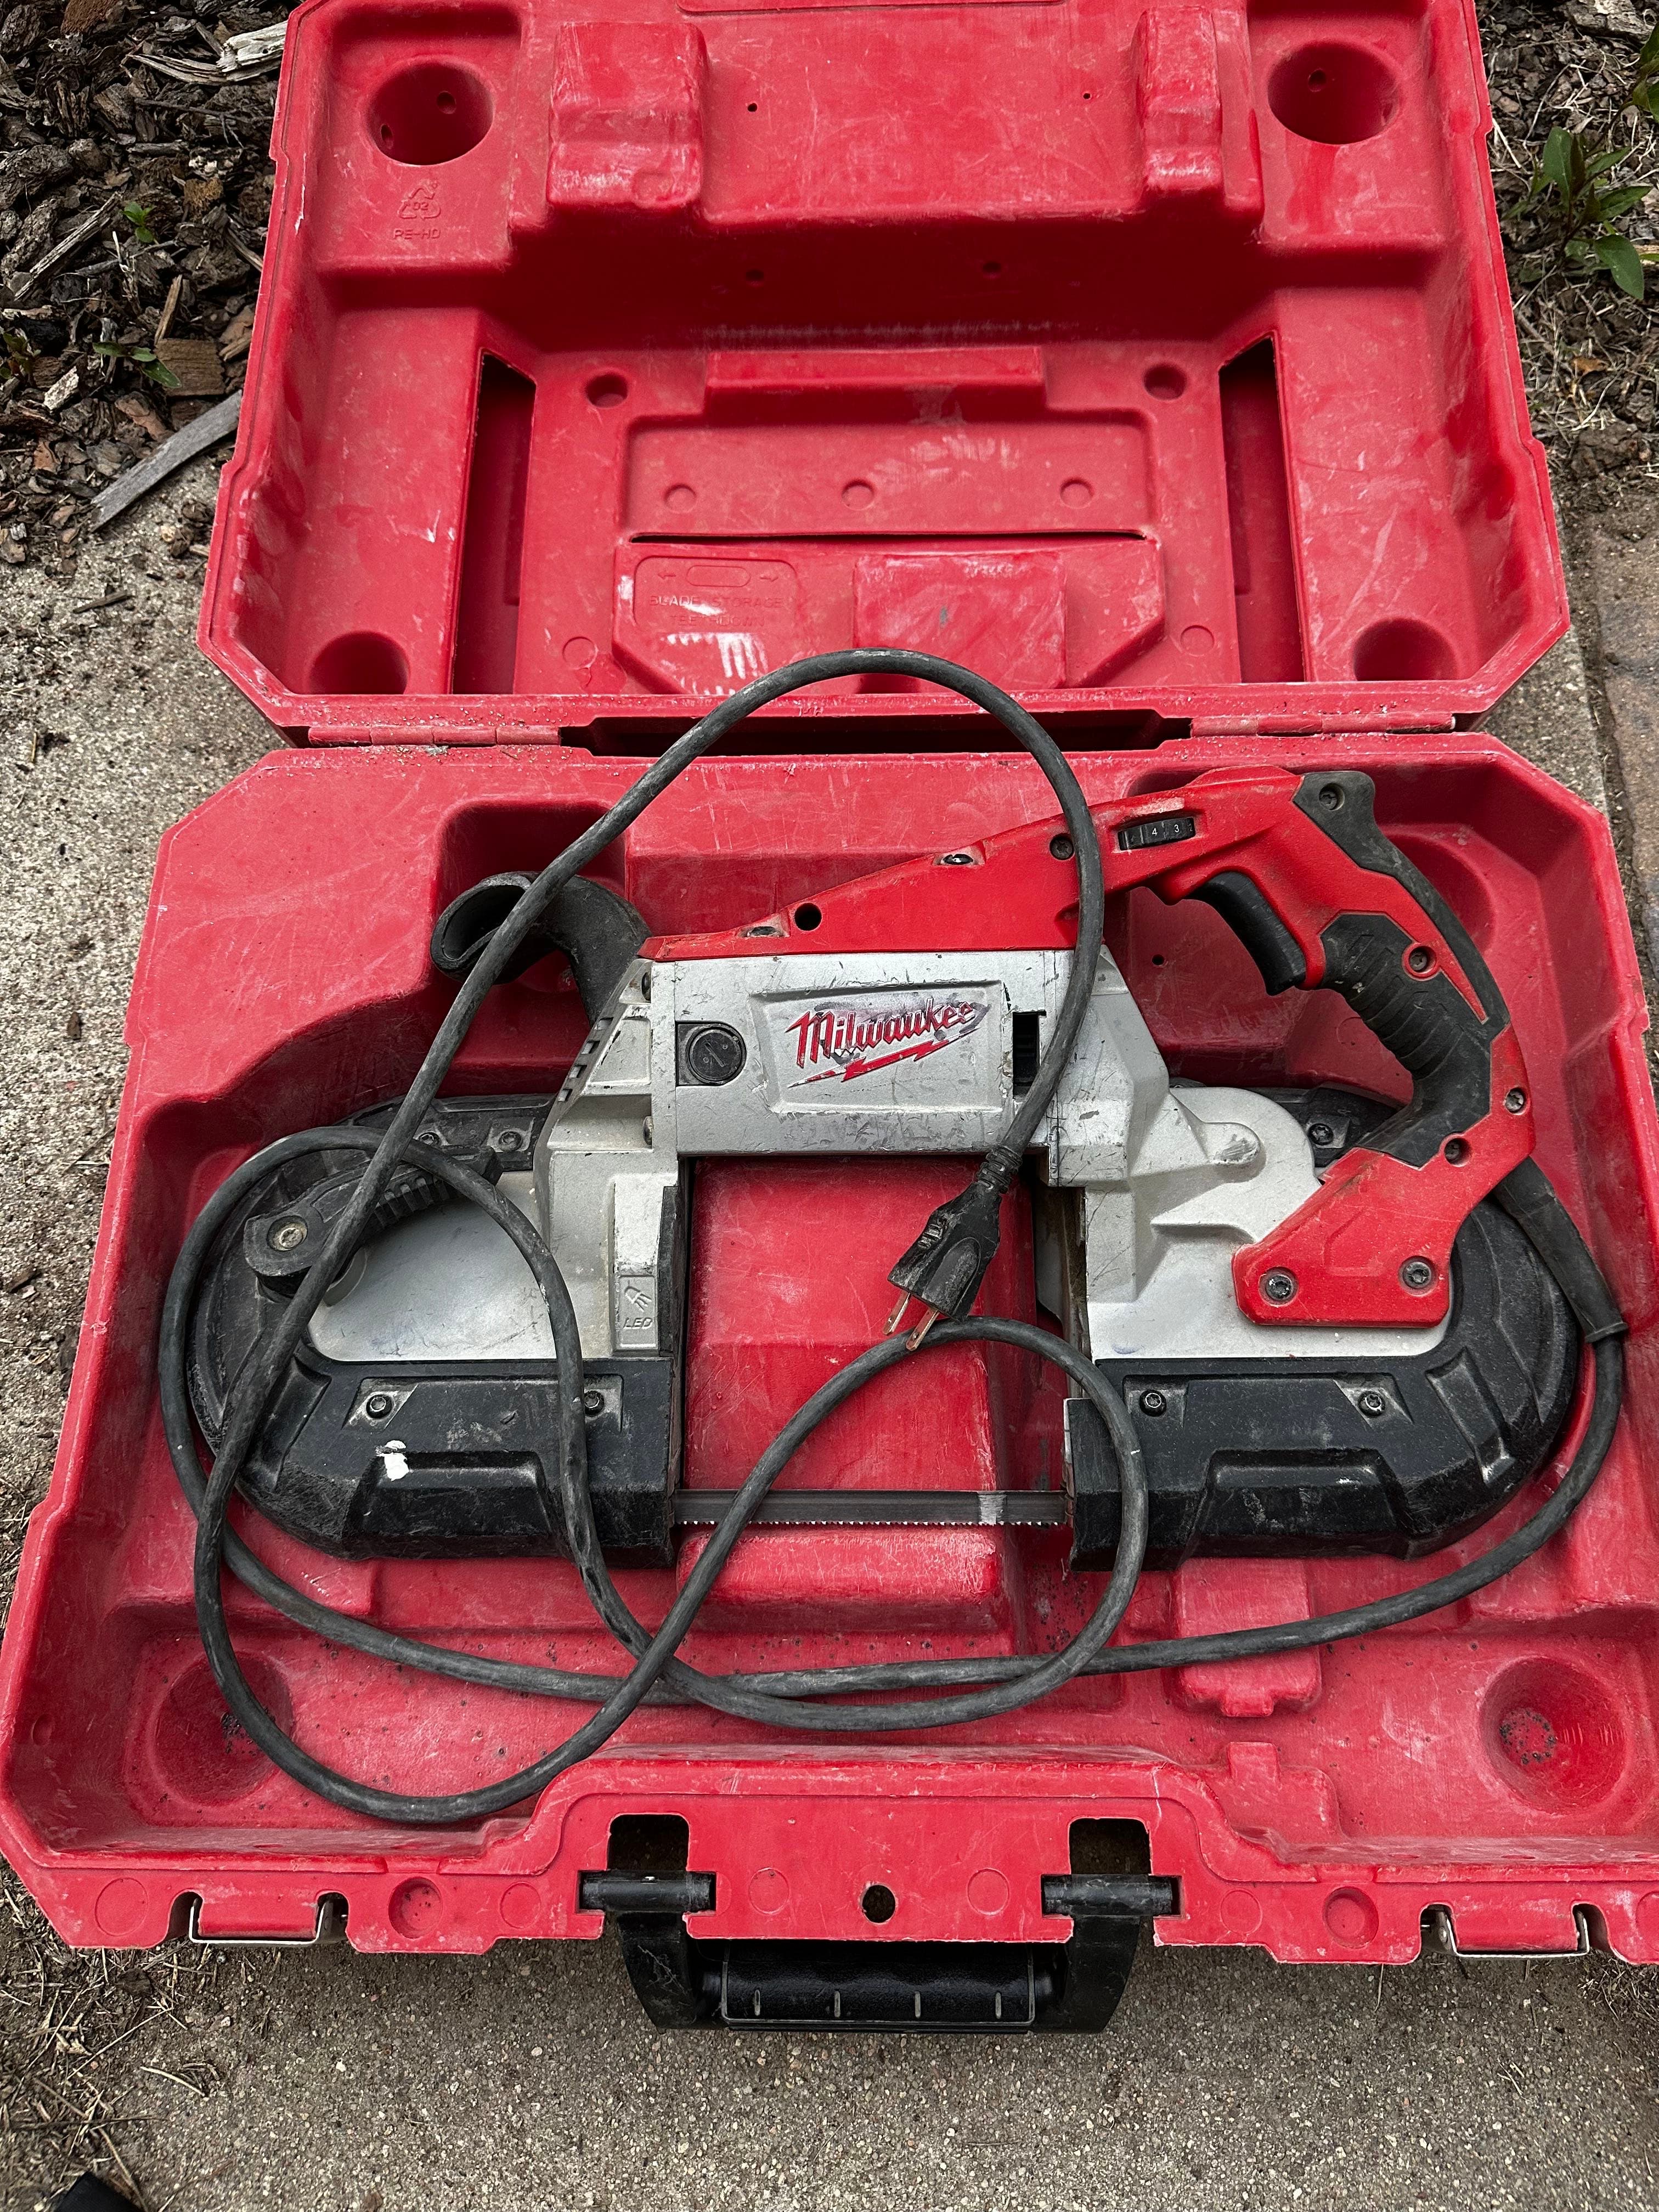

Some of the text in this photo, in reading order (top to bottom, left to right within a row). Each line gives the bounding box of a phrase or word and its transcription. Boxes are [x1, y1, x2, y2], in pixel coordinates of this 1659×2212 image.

[413, 201, 429, 211] 02
[393, 228, 441, 240] PE-HD
[650, 595, 784, 608] BLADE STORAGE
[1152, 827, 1158, 837] 4
[1174, 824, 1180, 833] 3
[785, 996, 977, 1069] Milwaukee
[623, 1317, 653, 1330] LED
